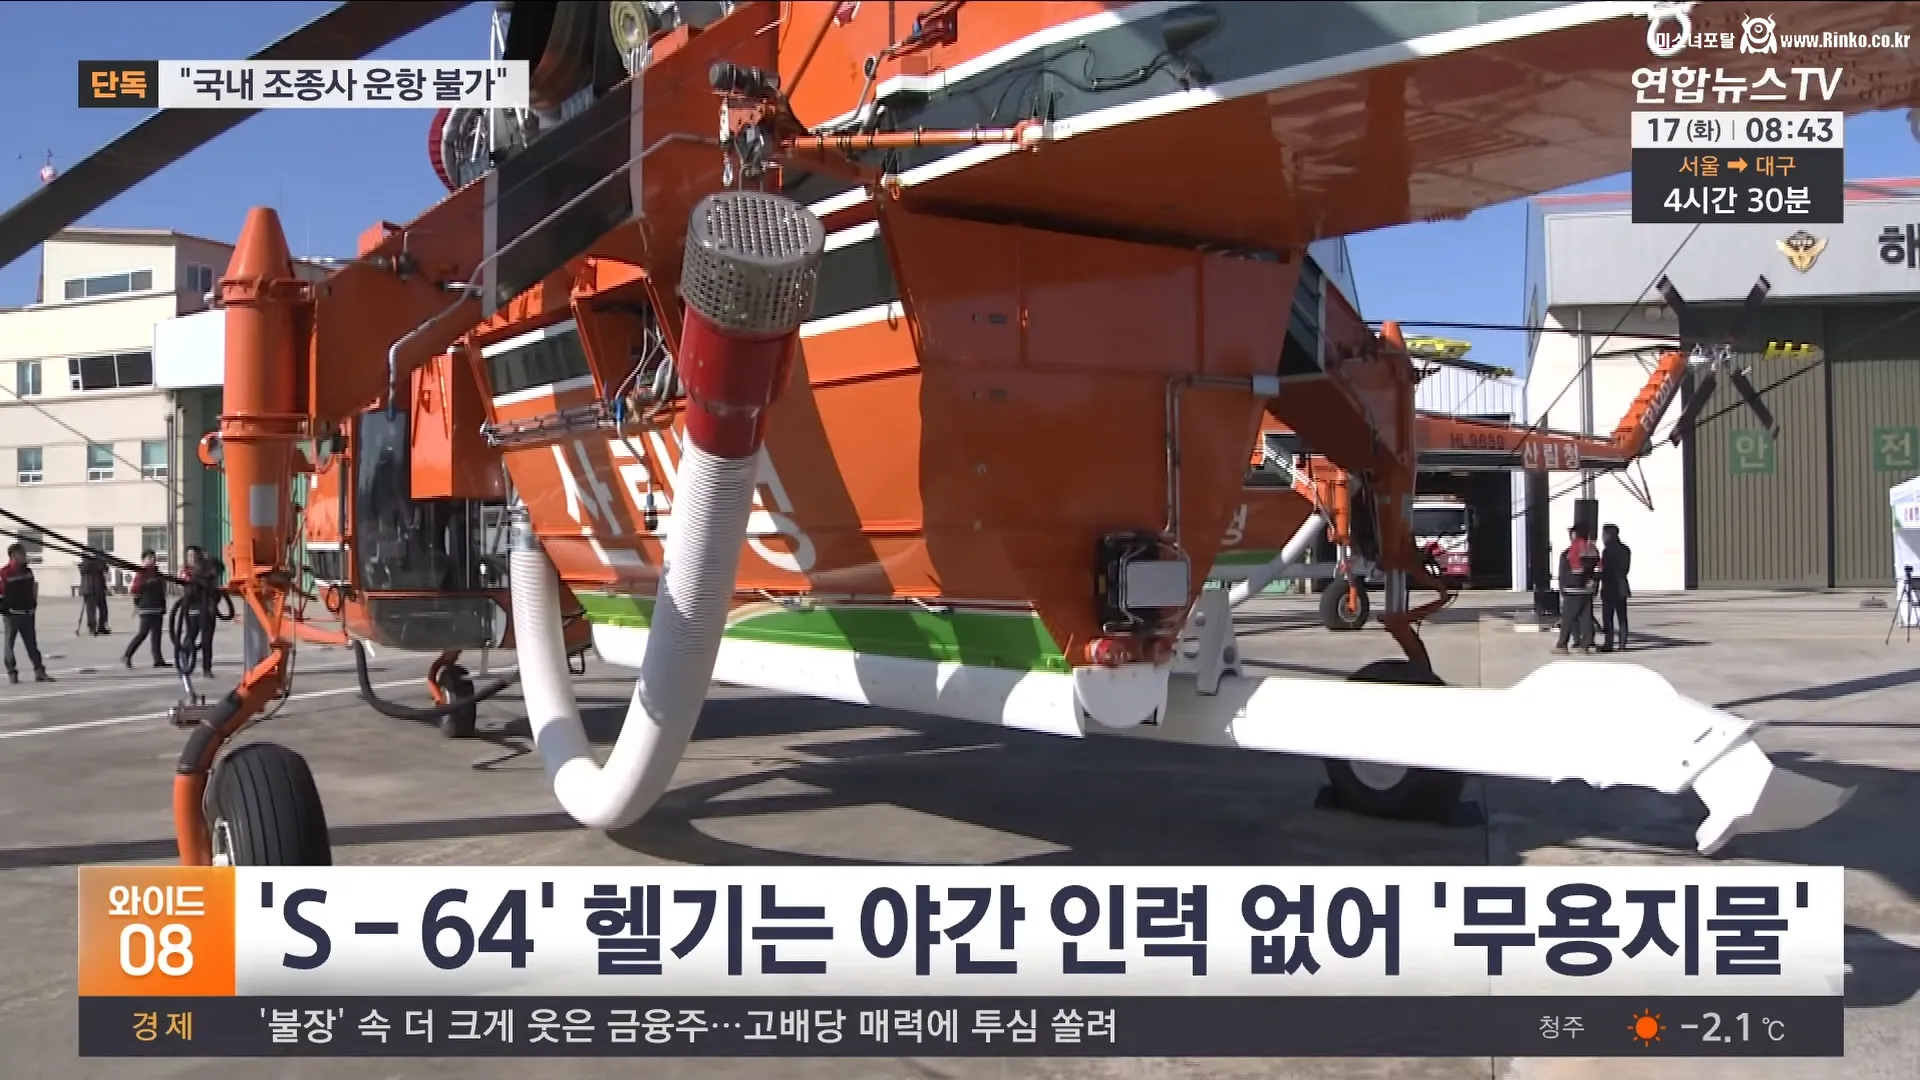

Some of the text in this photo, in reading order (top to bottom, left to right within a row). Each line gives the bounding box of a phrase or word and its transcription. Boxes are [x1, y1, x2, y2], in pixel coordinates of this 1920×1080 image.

[1523, 441, 1579, 469] 산림청
[1736, 431, 1912, 468] 안 전
